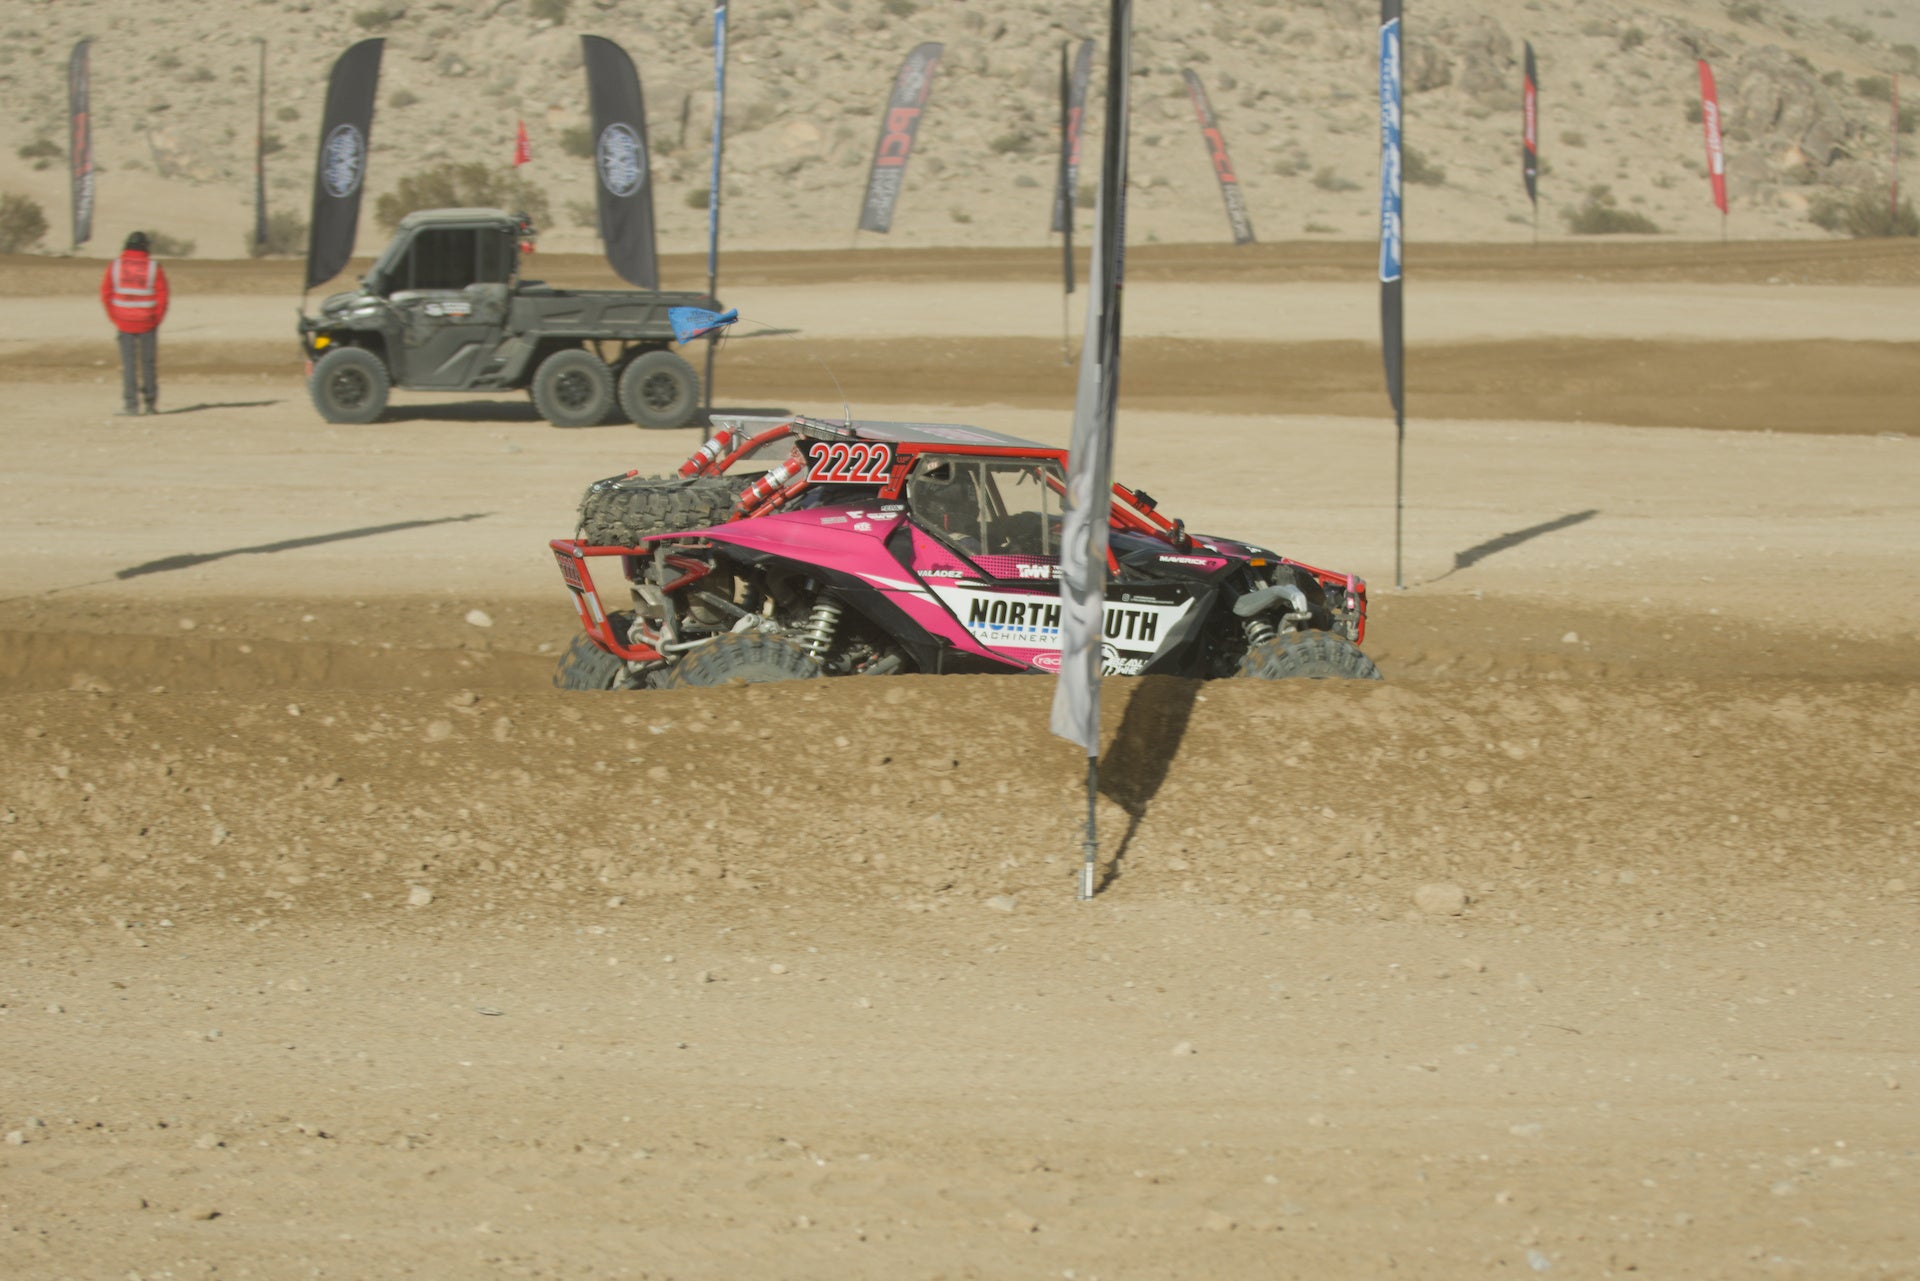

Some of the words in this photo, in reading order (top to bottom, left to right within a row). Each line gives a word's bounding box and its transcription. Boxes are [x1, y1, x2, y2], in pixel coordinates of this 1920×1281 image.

[807, 442, 891, 484] 2222
[1159, 555, 1206, 566] MAVERICK
[917, 570, 963, 578] VALADEZ
[967, 598, 1062, 634] NORTH
[1104, 609, 1159, 641] UTH
